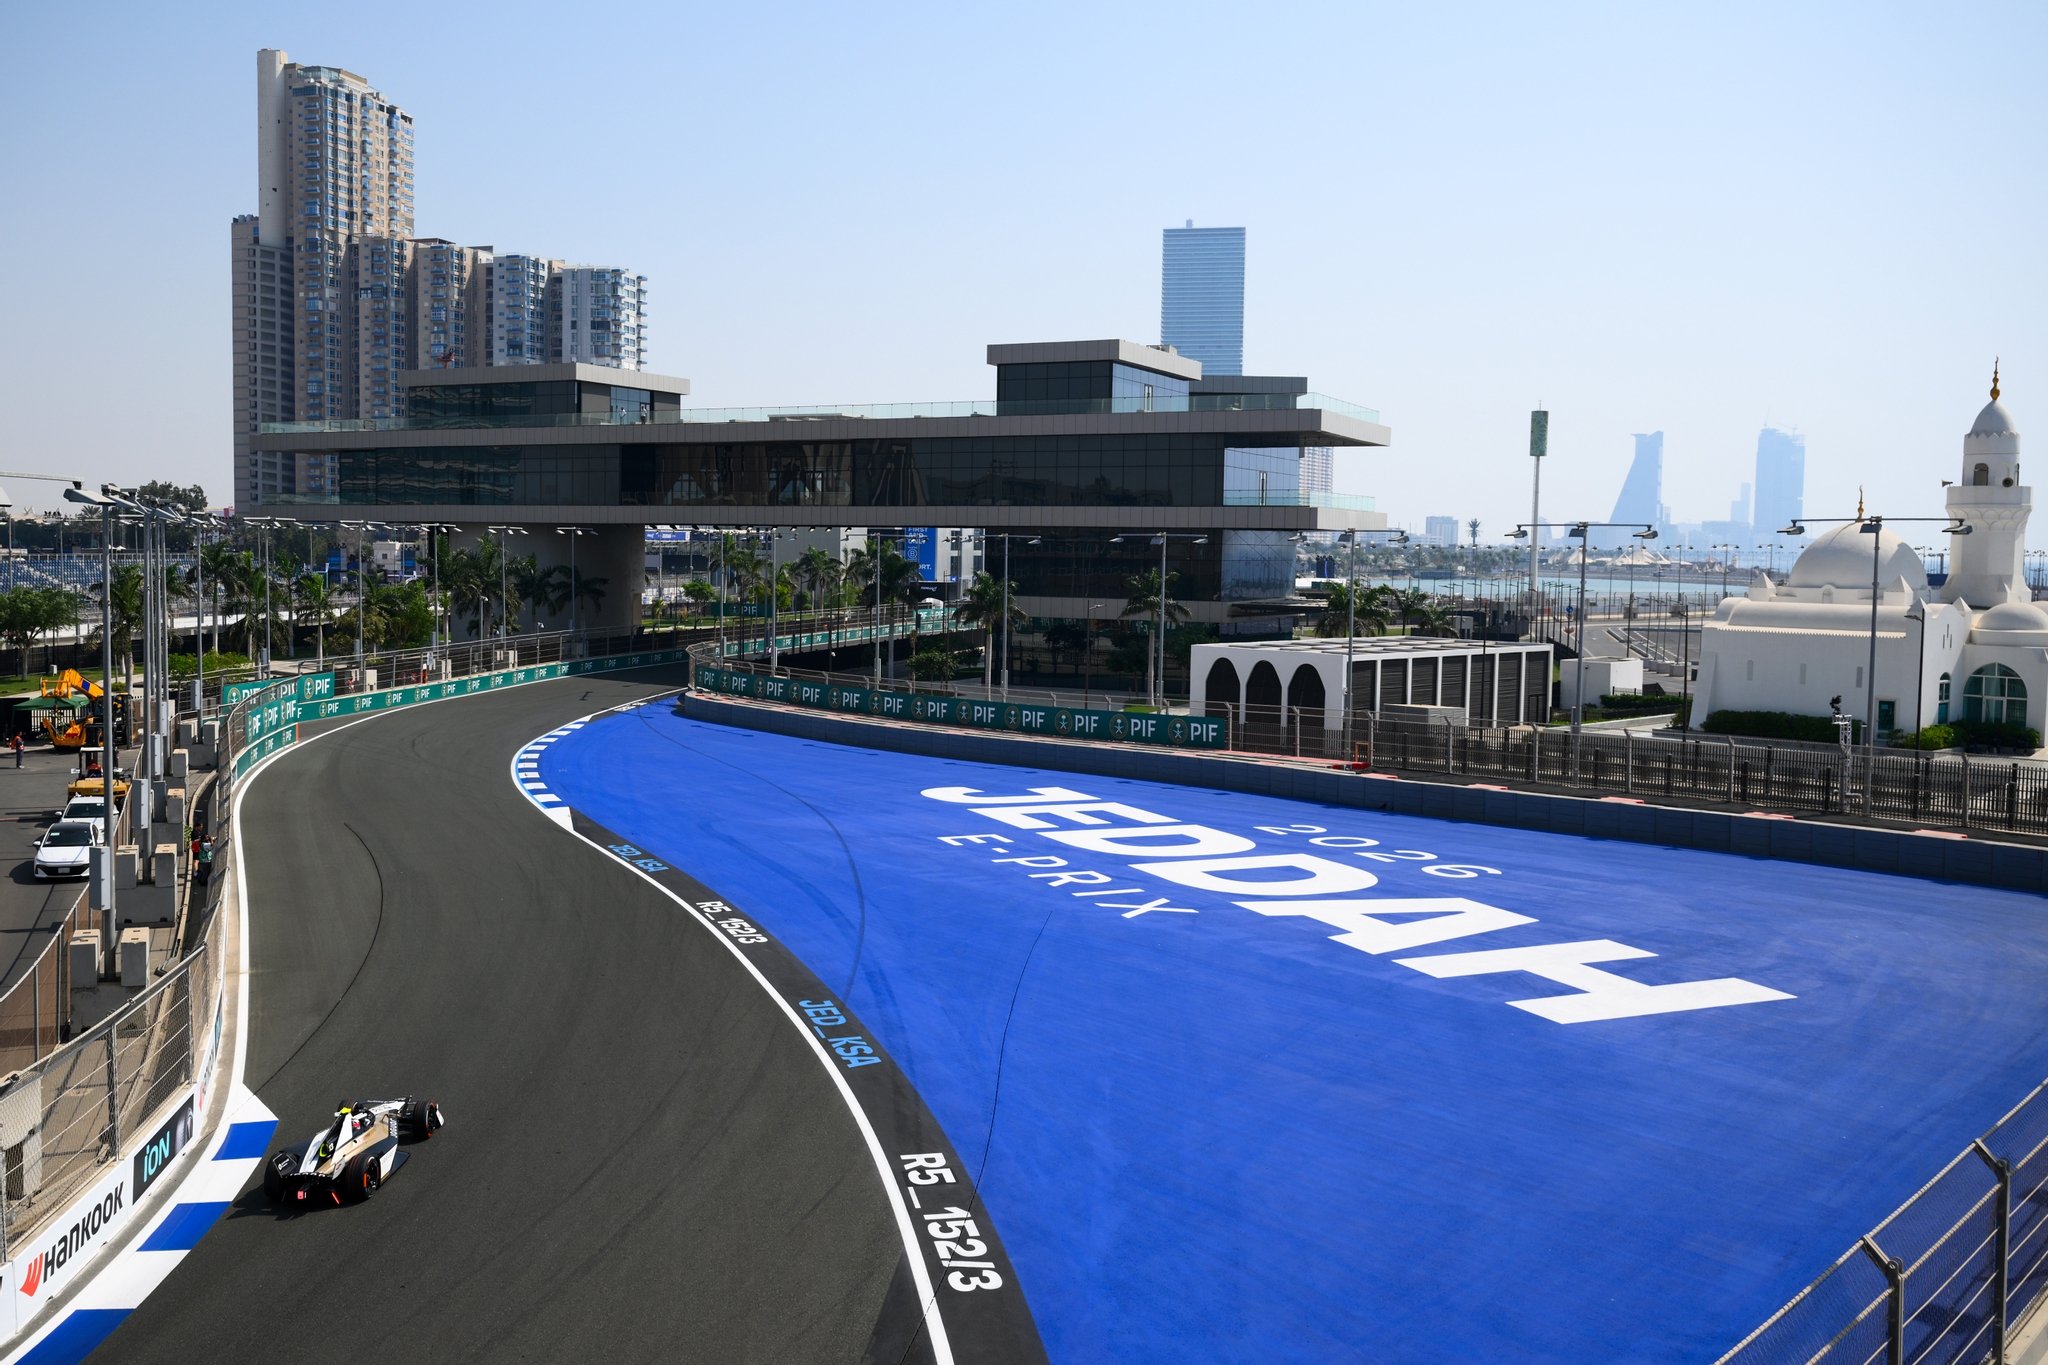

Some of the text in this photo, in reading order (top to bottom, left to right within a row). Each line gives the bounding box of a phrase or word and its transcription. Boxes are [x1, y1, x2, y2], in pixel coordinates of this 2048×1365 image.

[742, 606, 757, 615] PIF
[315, 678, 331, 695] PIF
[328, 702, 339, 714] PIF
[362, 697, 372, 708] PIF
[392, 692, 403, 704] PIF
[421, 689, 430, 699] PIF
[447, 684, 456, 694] PIF
[472, 680, 481, 690] PIF
[495, 675, 503, 686] PIF
[517, 672, 525, 682] PIF
[539, 668, 547, 678] PIF
[562, 664, 570, 674] PIF
[584, 661, 593, 671] PIF
[608, 659, 617, 668] PIF
[632, 656, 640, 665] PIF
[654, 653, 662, 662] PIF
[704, 671, 1218, 742] PIF PIF PIF PIF PIF PIF PIF PIF PIF PIF PIF PIF
[253, 714, 261, 736] PIF
[268, 707, 278, 727] PIF
[286, 700, 296, 719] PIF
[608, 843, 669, 873] JED_KSA
[937, 833, 1199, 919] E-PRIX
[1253, 824, 1502, 878] 2026
[696, 900, 768, 944] R5_152/3
[920, 786, 1799, 1024] JEDDAH
[799, 999, 882, 1068] JED_KSA
[900, 1152, 1003, 1292] R5_152/3
